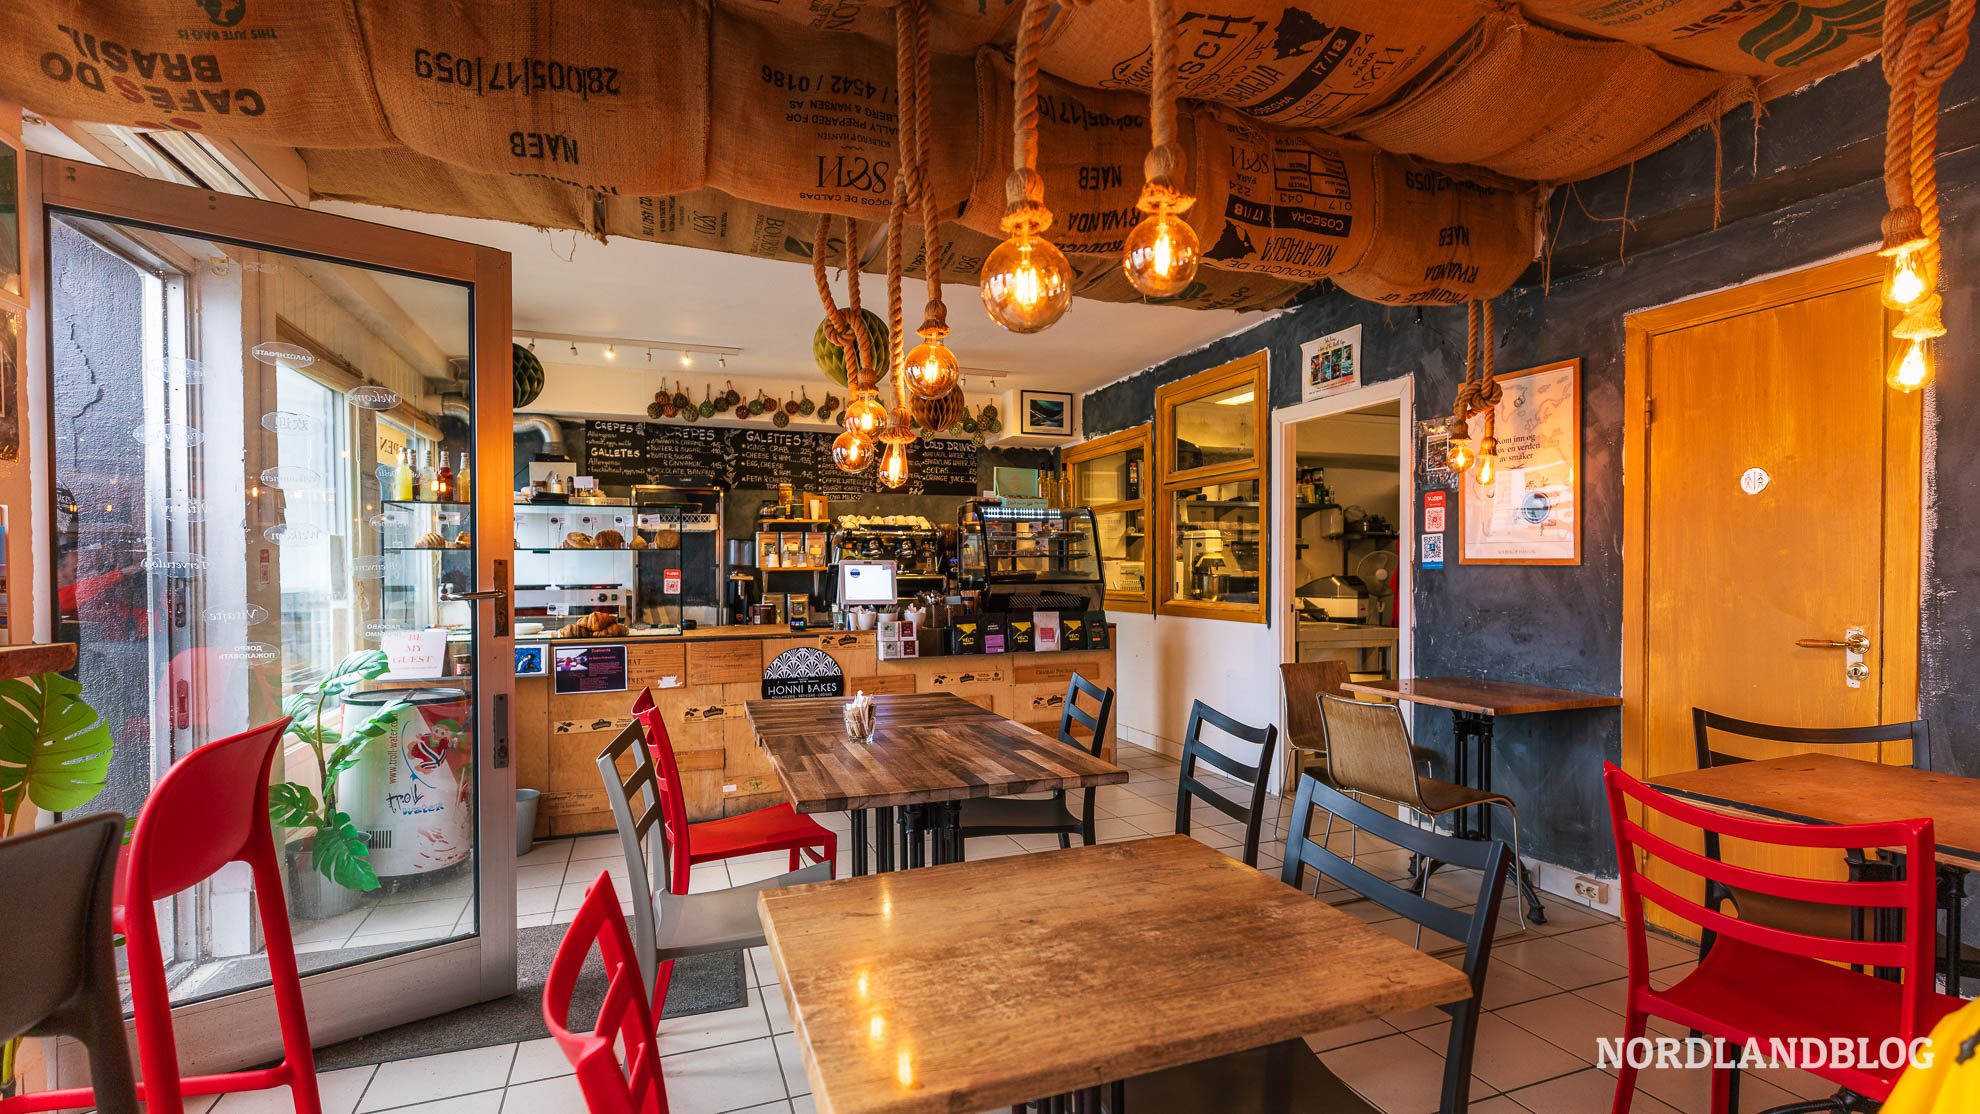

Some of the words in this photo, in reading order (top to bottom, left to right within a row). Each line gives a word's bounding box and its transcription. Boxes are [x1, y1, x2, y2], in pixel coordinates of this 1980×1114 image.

[177, 30, 188, 40] IS
[193, 30, 219, 41] BAG
[223, 30, 247, 40] JUTE
[251, 28, 276, 39] THIS
[57, 24, 223, 83] BRASIL
[1312, 38, 1348, 73] 17/18
[1345, 32, 1375, 67] 224
[1352, 51, 1376, 76] PARA
[40, 53, 105, 93] DO
[761, 65, 810, 91] 0186
[831, 75, 876, 100] 4542
[112, 76, 265, 116] CAFÉS
[789, 101, 803, 110] AS
[810, 100, 851, 114] HANSEN
[855, 105, 862, 115] &
[785, 113, 809, 123] FOR
[812, 114, 866, 129] PREPARED
[509, 132, 579, 165] NAEB
[1078, 166, 1122, 191] NAEB
[1237, 173, 1257, 185] PARA
[1229, 180, 1251, 197] 224
[800, 192, 841, 202] CALDAS
[845, 195, 858, 203] DE
[1280, 192, 1303, 203] 043
[1234, 203, 1263, 221] 17/18
[1068, 208, 1140, 233] RWANDA
[1291, 212, 1344, 231] COSECHA
[1438, 225, 1470, 247] NAEB
[1260, 237, 1338, 268] NICARAGUA
[1225, 260, 1250, 270] DE
[1253, 264, 1330, 279] PRODUCTO
[1423, 262, 1479, 284] RWANDA
[595, 421, 634, 433] CREPES
[746, 431, 801, 446] GALETTES
[1527, 434, 1536, 442] og
[591, 448, 640, 458] GALLETES
[923, 441, 944, 450] COLD
[946, 441, 977, 452] DRINKS
[1517, 442, 1541, 451] verden
[768, 684, 804, 695] HONNI
[807, 683, 837, 693] BAKES
